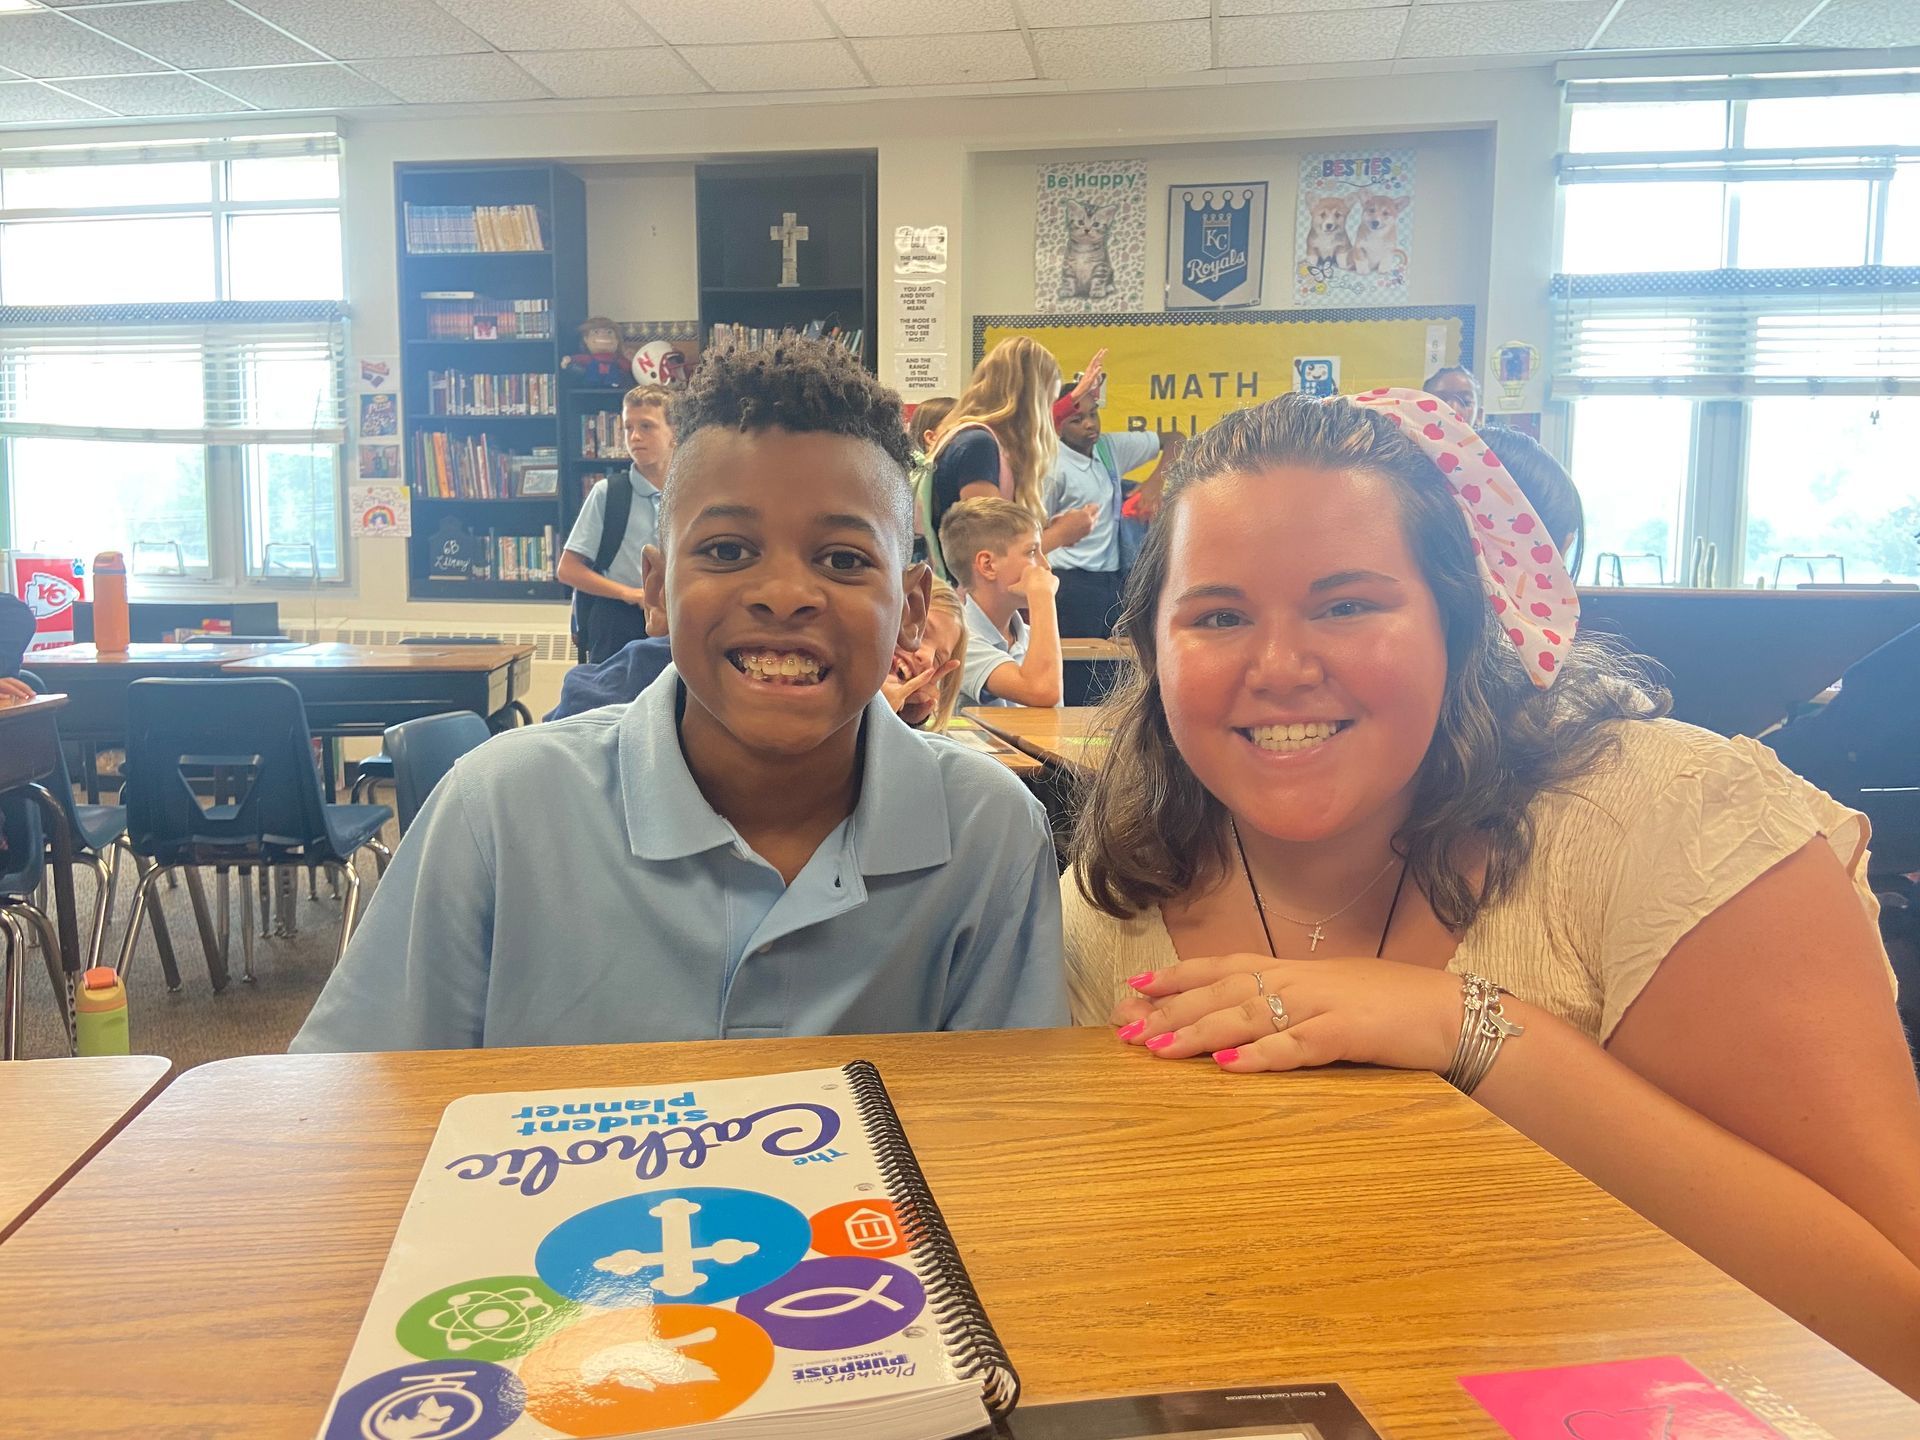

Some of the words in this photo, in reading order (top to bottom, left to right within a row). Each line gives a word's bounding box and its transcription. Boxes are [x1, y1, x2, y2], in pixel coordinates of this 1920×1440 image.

[1047, 174, 1068, 188] Be
[1075, 173, 1136, 189] Happy
[1206, 229, 1228, 250] KC
[1187, 249, 1246, 283] Royals
[637, 352, 655, 373] N
[1151, 372, 1258, 400] MATH
[37, 583, 67, 606] KC
[511, 1092, 696, 1119] planner
[516, 1110, 708, 1136] student
[444, 1102, 841, 1196] Catholic
[793, 1148, 849, 1166] The
[792, 1354, 909, 1380] PURPOSE
[841, 1352, 884, 1361] SUCCESS
[824, 1362, 916, 1384] Planners
